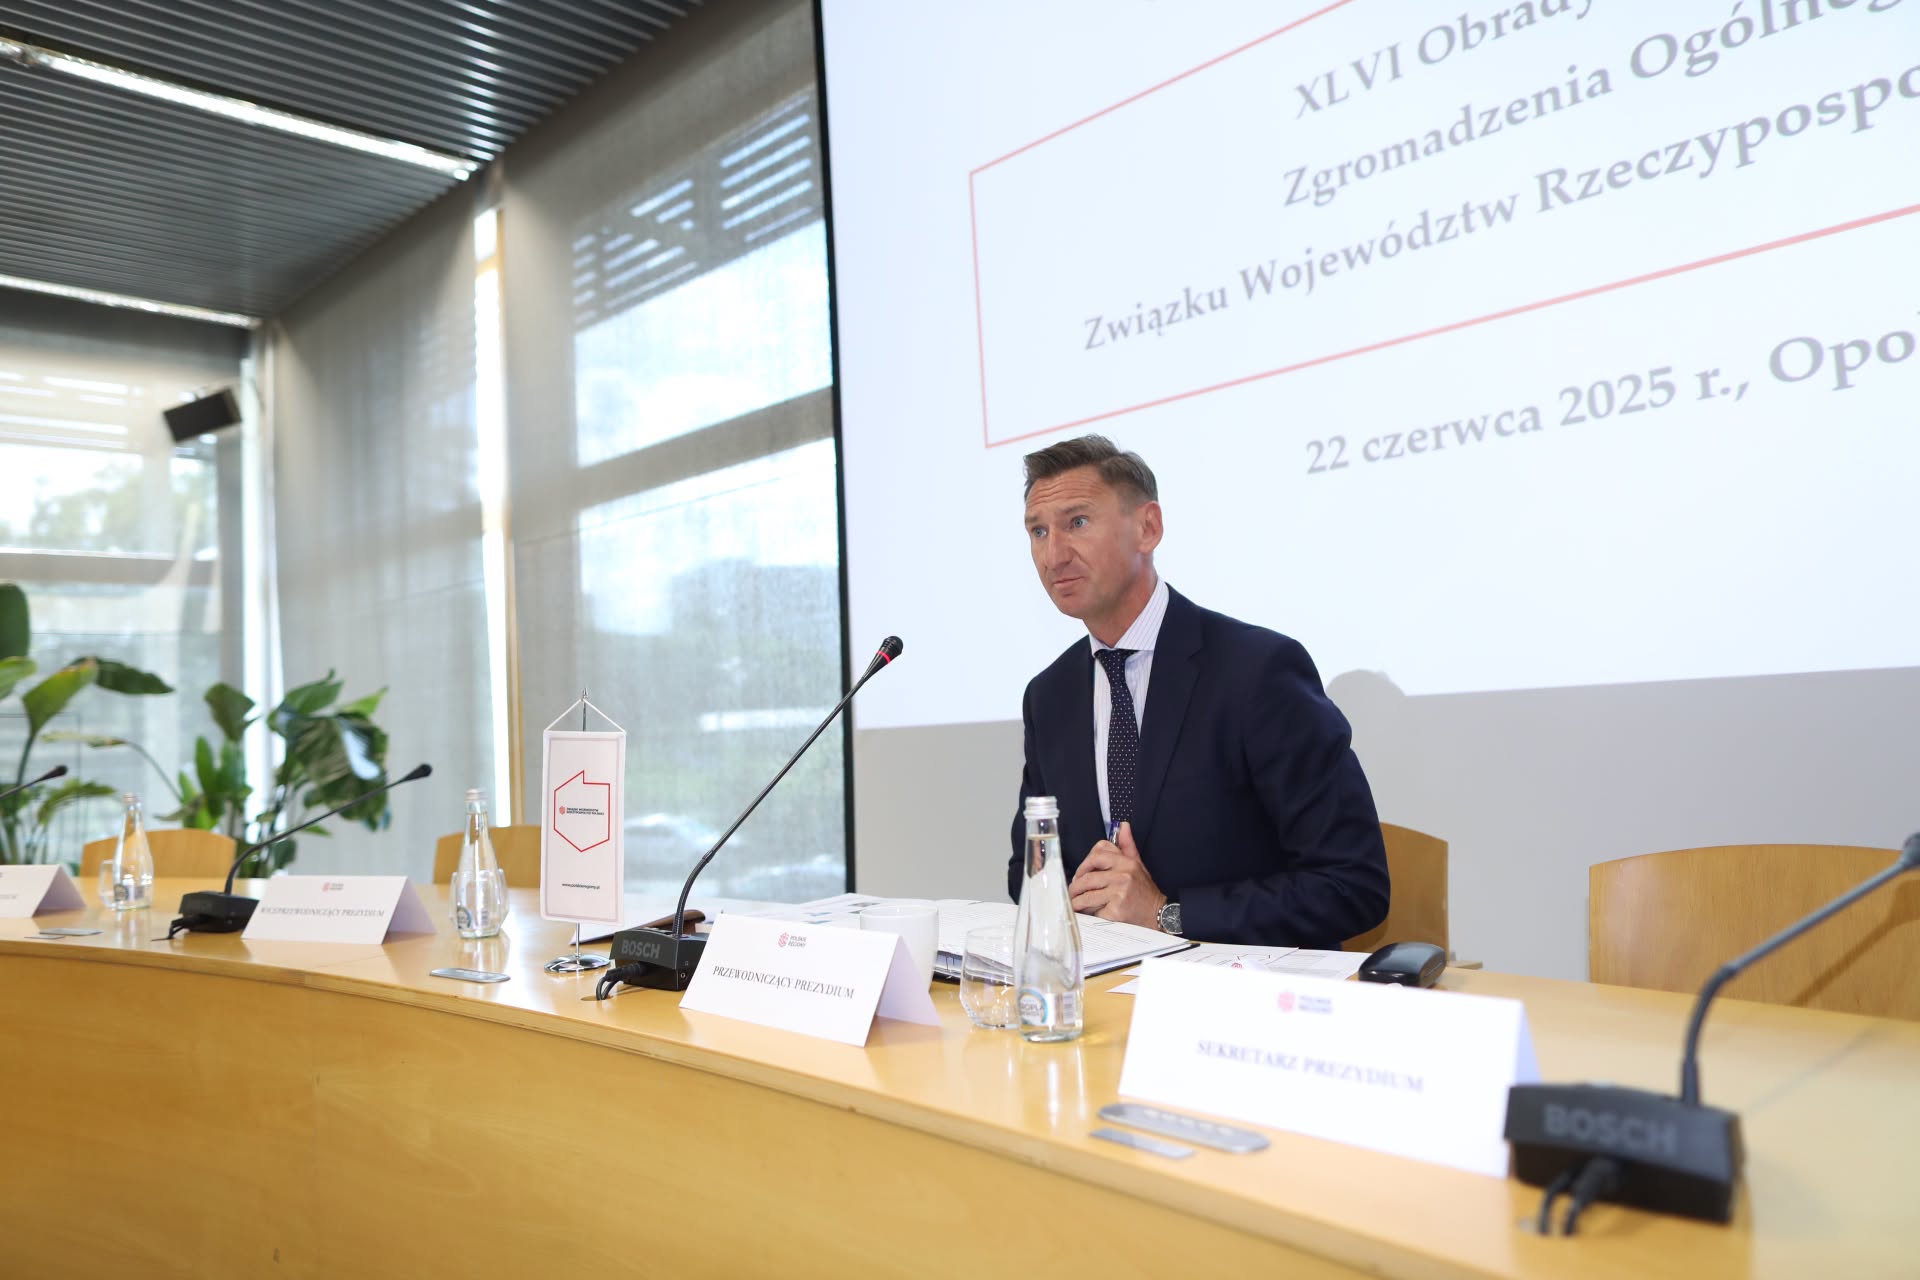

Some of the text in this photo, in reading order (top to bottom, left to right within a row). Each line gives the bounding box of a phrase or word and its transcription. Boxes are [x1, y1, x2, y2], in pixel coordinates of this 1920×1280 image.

[1283, 0, 1903, 208] Zgromadzenia Ogóln
[1294, 42, 1403, 119] XLVI
[1084, 286, 1229, 351] Związku
[1240, 193, 1520, 302] Województw
[1305, 313, 1920, 475] 22 czerwca 2025 r., Opo
[621, 939, 661, 959] BOSCH
[712, 965, 856, 999] PRZEWODNICZĄCY PREZYDIUM
[1197, 1039, 1425, 1094] SEKRETARZ PREZYDIUM
[1543, 1103, 1678, 1157] BOSCH
